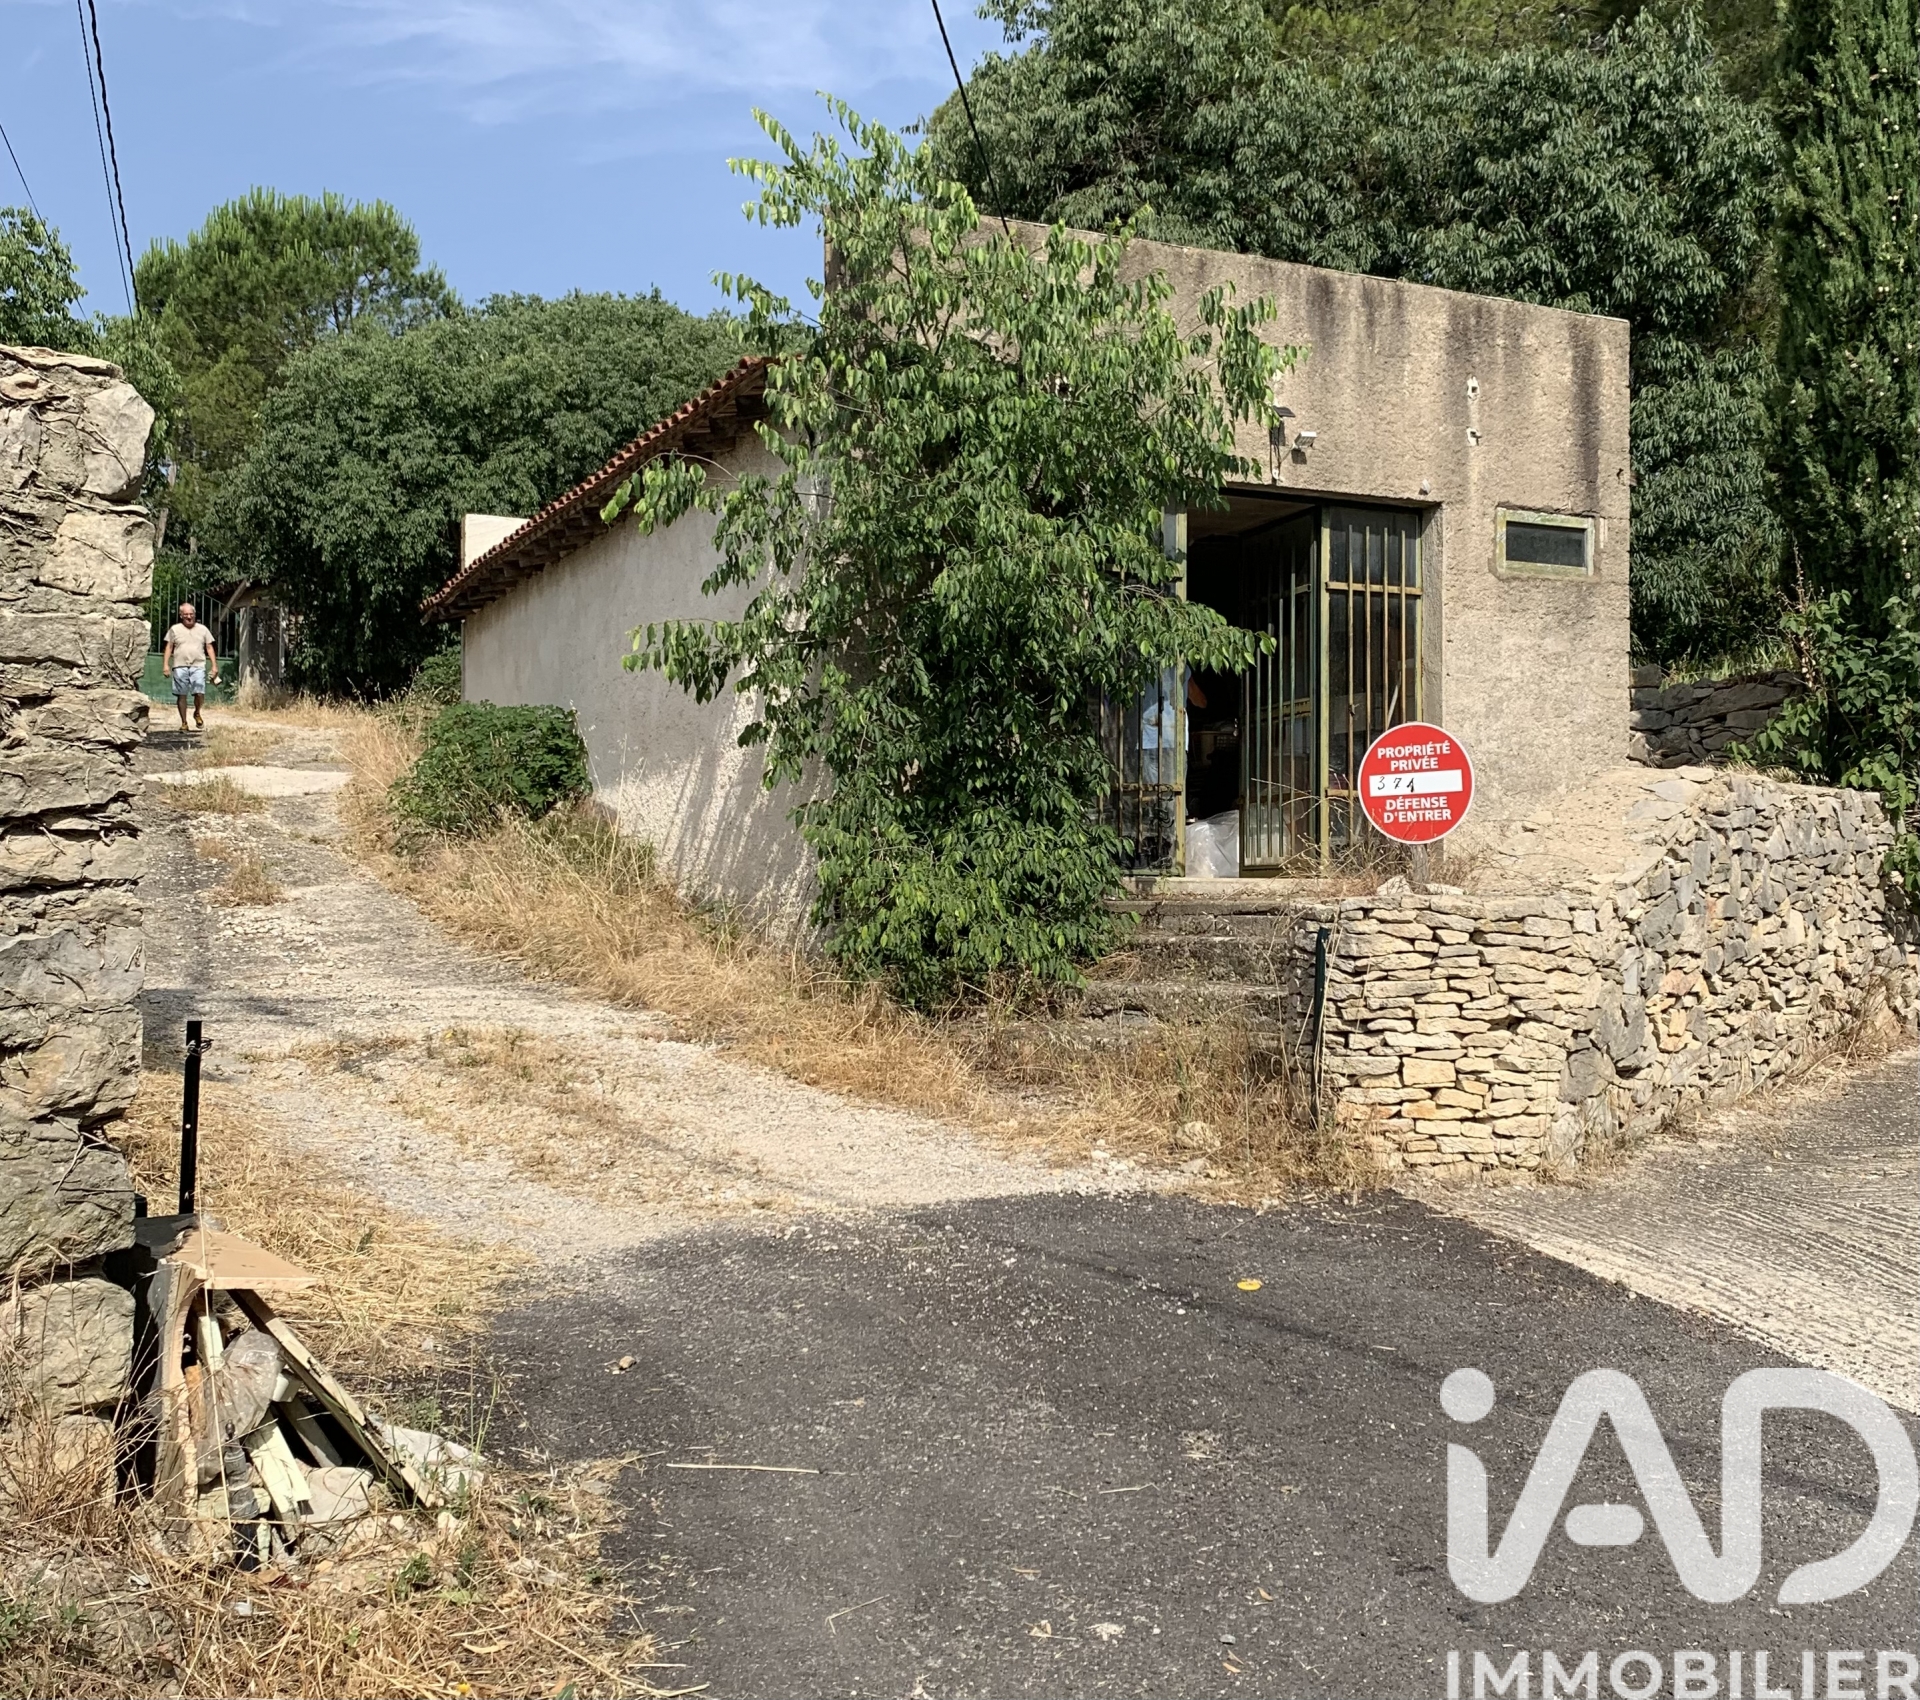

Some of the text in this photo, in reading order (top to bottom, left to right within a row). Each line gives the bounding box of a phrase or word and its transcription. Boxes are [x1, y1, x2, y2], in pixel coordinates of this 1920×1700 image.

[1377, 740, 1451, 759] PROPRIÉTÉ
[1390, 757, 1439, 771] PRIVÉE
[1385, 796, 1448, 811] DÉFENSE
[1383, 809, 1452, 823] D'ENTRER
